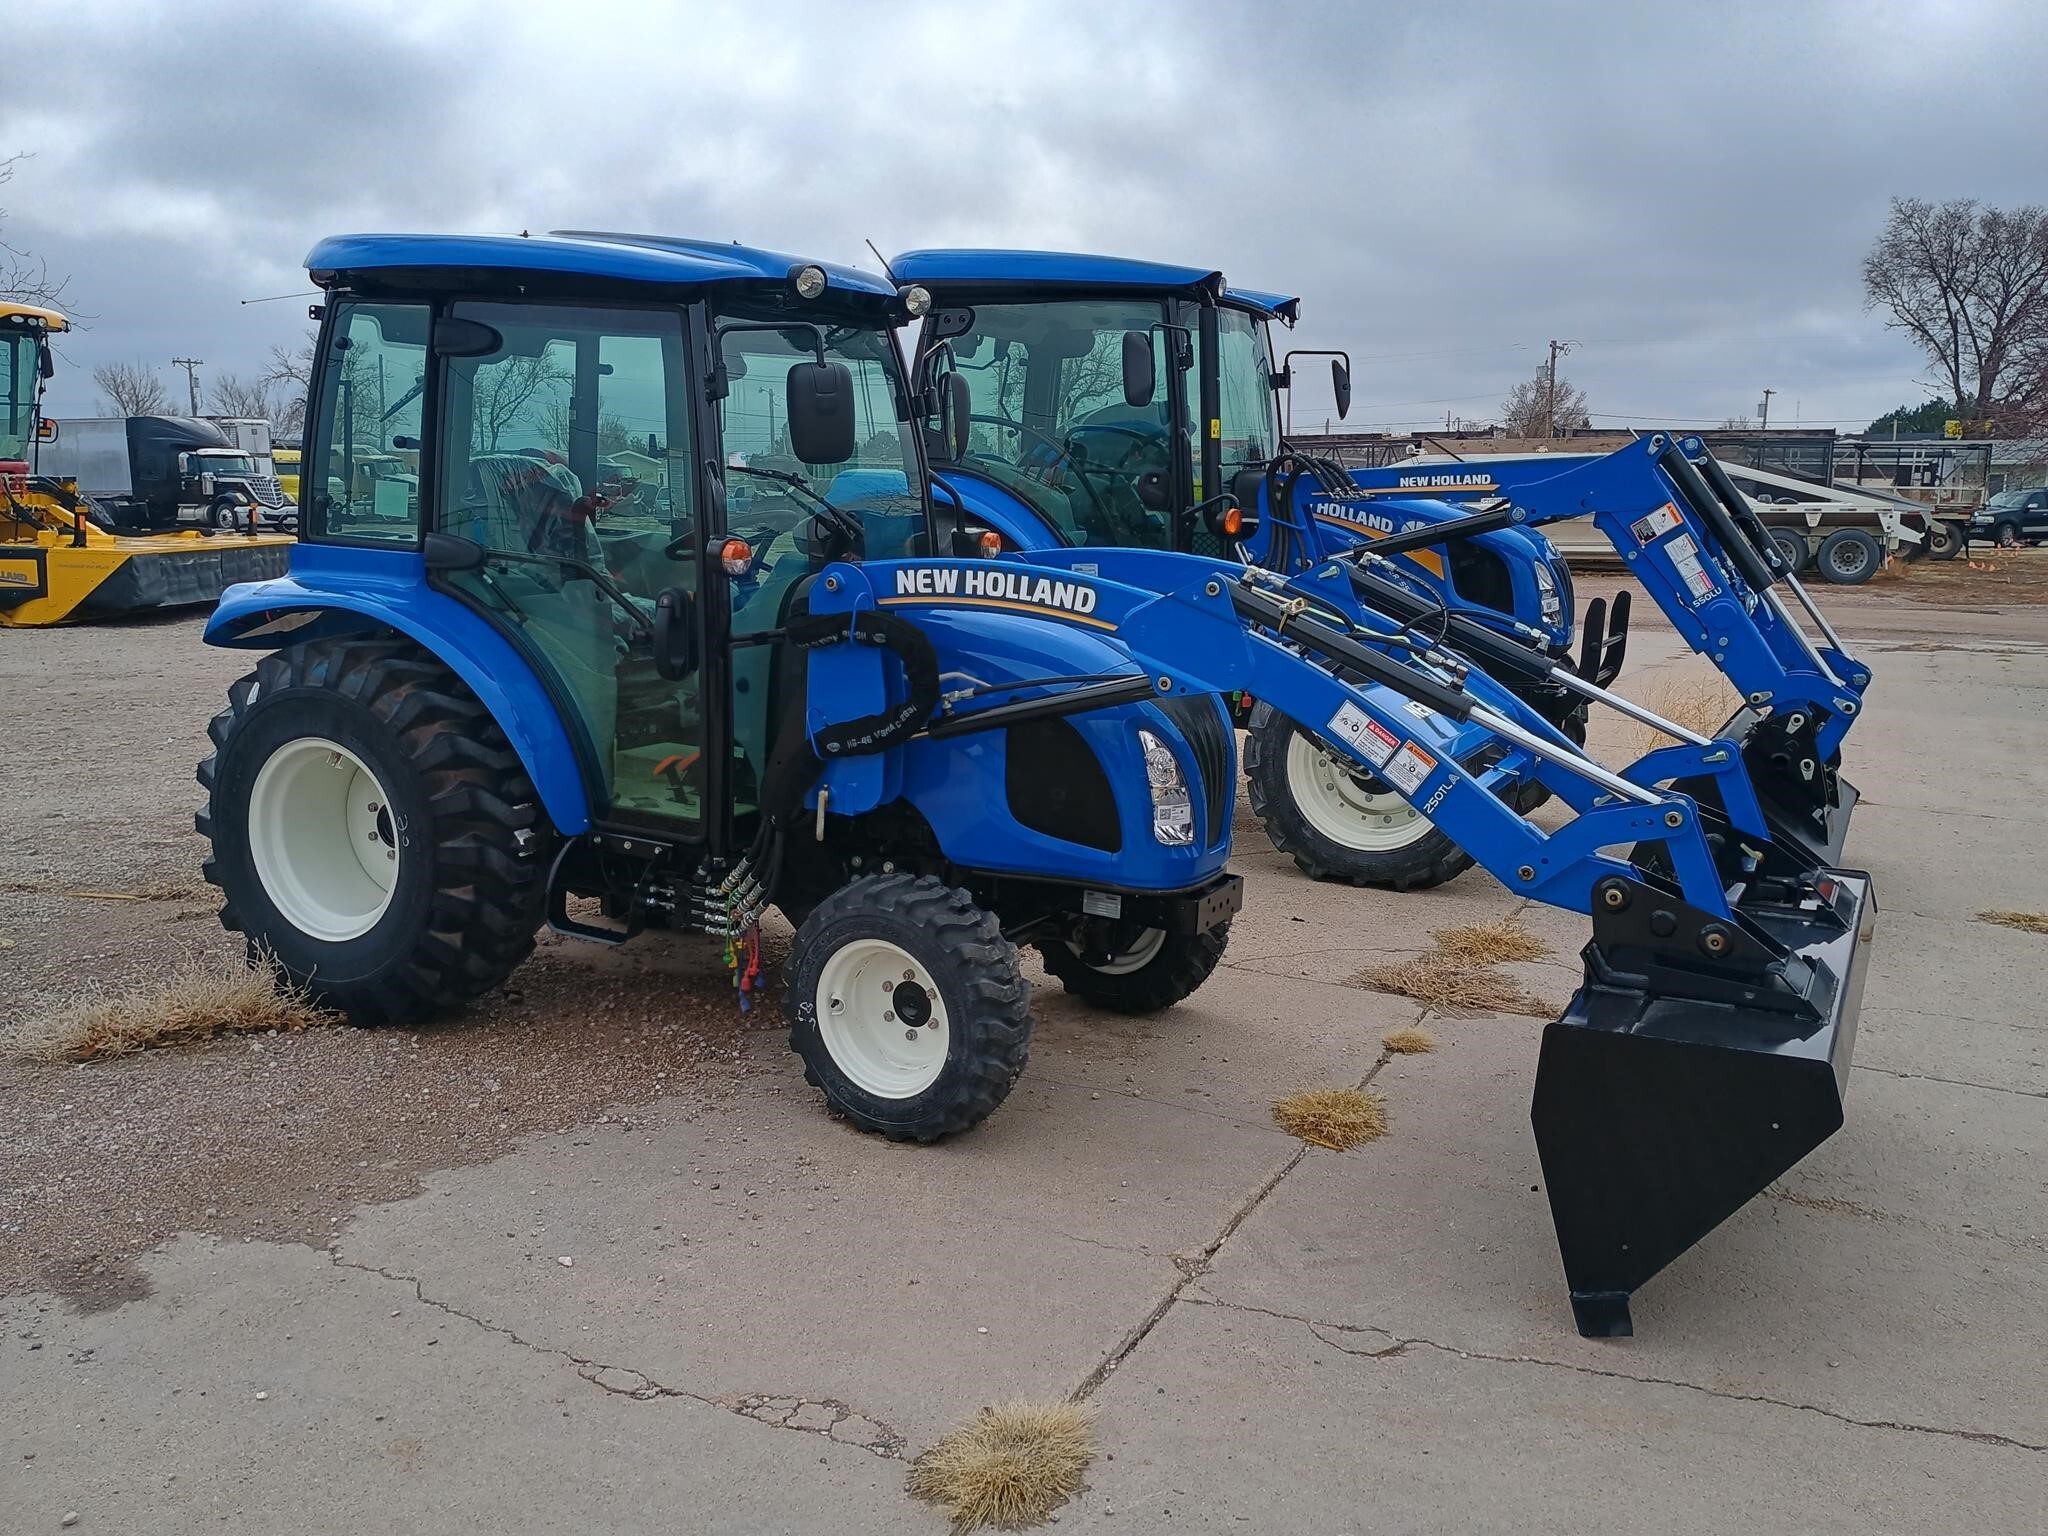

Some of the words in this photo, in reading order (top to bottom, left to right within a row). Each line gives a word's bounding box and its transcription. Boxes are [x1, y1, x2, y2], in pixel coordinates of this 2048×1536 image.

[1400, 476, 1429, 487] NEW
[1431, 474, 1491, 486] HOLLAND
[1316, 502, 1394, 533] HOLLAND
[896, 569, 959, 594] NEW
[965, 570, 1096, 614] HOLLAND
[1692, 586, 1722, 608] 550LU
[1374, 727, 1397, 747] DANGER
